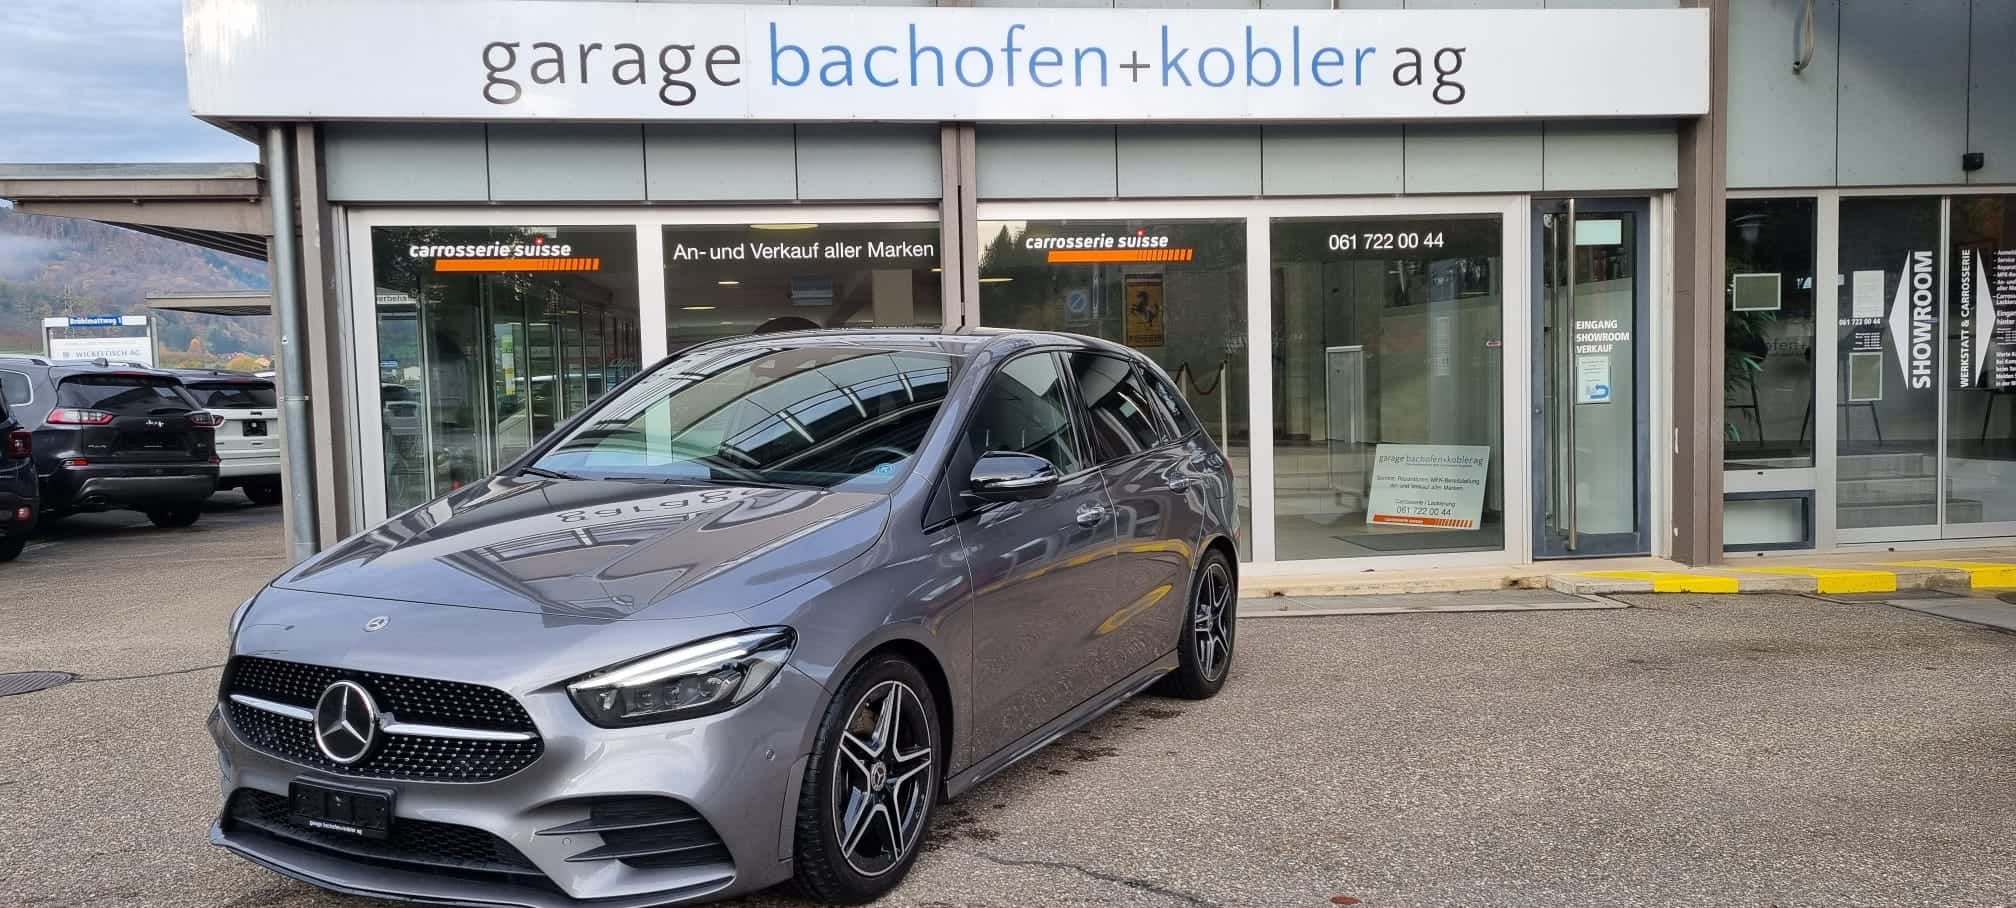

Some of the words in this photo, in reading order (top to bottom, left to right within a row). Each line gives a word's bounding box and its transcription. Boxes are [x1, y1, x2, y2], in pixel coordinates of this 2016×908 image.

[482, 40, 741, 106] garage
[1392, 44, 1467, 105] ag
[409, 241, 509, 258] carrosserie
[513, 236, 572, 257] suisse
[1025, 233, 1114, 249] carrosserie
[1118, 228, 1169, 248] suisse
[1328, 234, 1358, 250] 061
[1364, 233, 1394, 249] 722
[1398, 233, 1419, 248] 00
[1423, 232, 1445, 247] 44
[673, 243, 707, 261] An-
[710, 243, 745, 260] und
[750, 242, 819, 259] Verkauf
[824, 242, 862, 259] aller
[868, 241, 934, 258] Marken
[1960, 249, 1971, 317] CARROSSERIE
[1576, 319, 1618, 330] EINGANG
[1912, 250, 1933, 390] SHOWROOM
[1961, 319, 1970, 327] &
[1576, 332, 1630, 342] SHOWROOM
[1576, 344, 1614, 354] VERKAUF
[1960, 329, 1970, 388] WERKSTATT
[1379, 455, 1405, 464] garage
[1473, 457, 1484, 466] ag
[1397, 506, 1410, 514] 061
[1413, 507, 1427, 515] 722
[1441, 508, 1451, 516] 44
